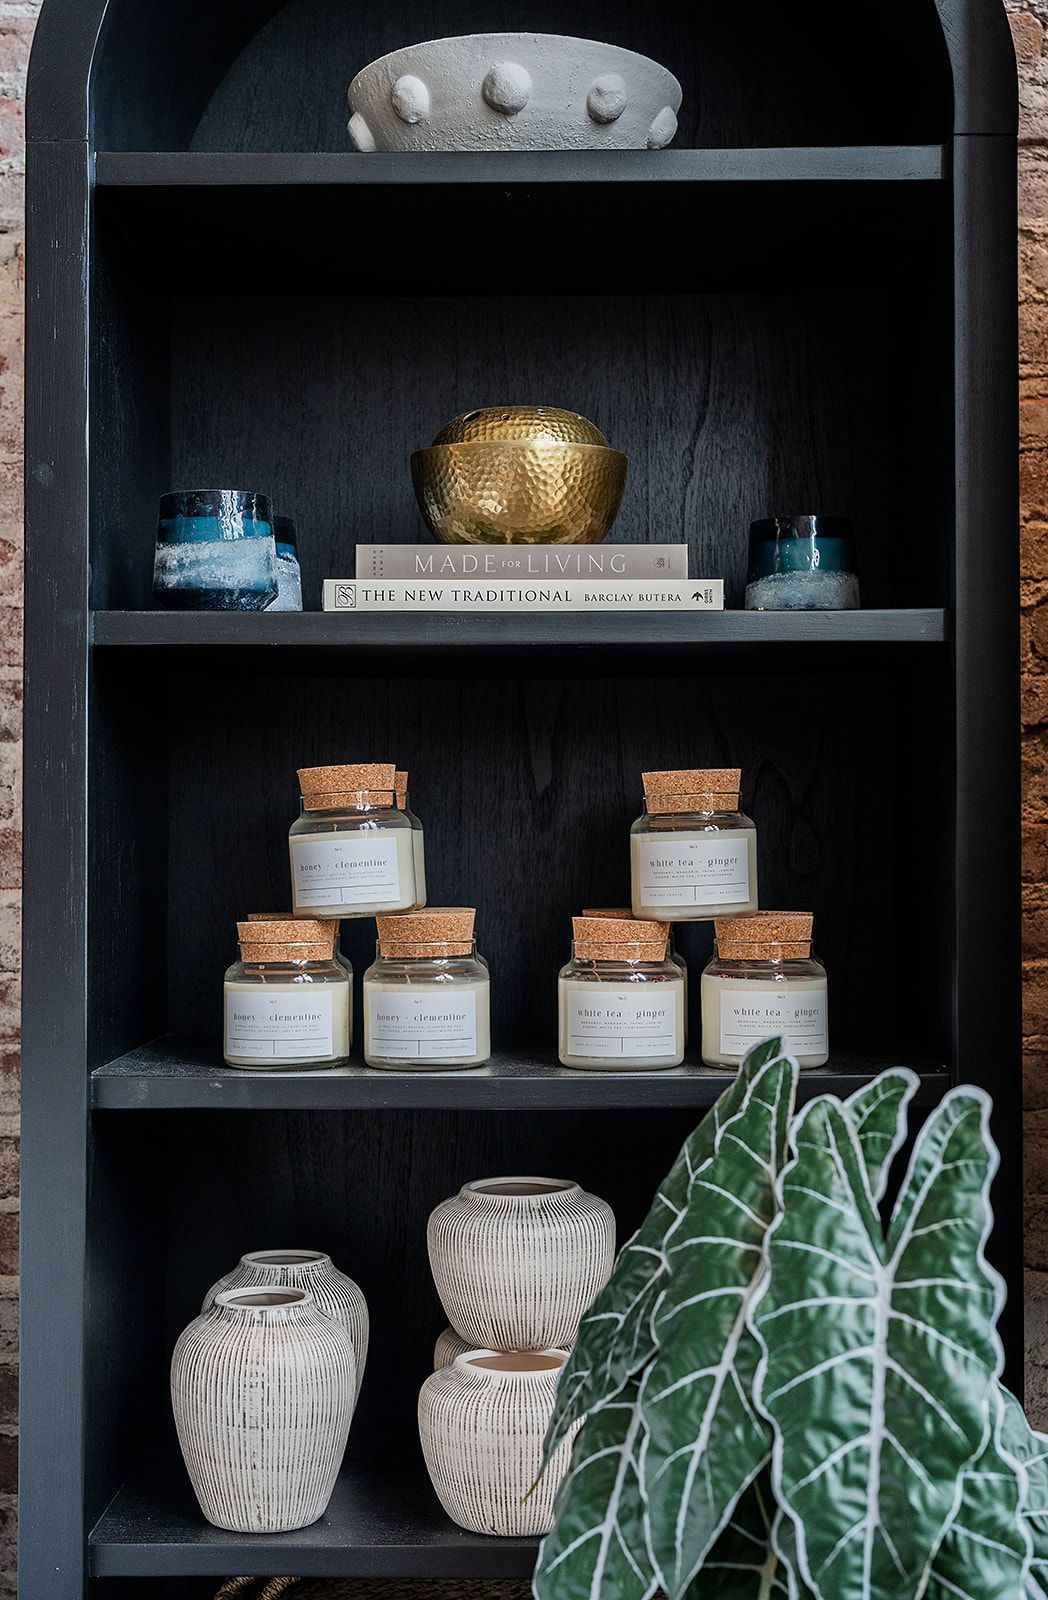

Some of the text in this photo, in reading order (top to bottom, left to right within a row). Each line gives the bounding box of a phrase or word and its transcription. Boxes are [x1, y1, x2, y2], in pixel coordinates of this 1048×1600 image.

[414, 553, 626, 573] MADE FOR LIVING
[362, 589, 682, 602] THE NEW TRADITIONAL BARCLAY BUTERA
[300, 858, 388, 873] honey clementine
[650, 856, 738, 868] white tea ginger
[233, 1012, 322, 1024] honey clementine
[376, 1012, 467, 1024] honey clementine
[577, 1008, 666, 1020] white tea ginger
[733, 1007, 821, 1019] white tea ginger
